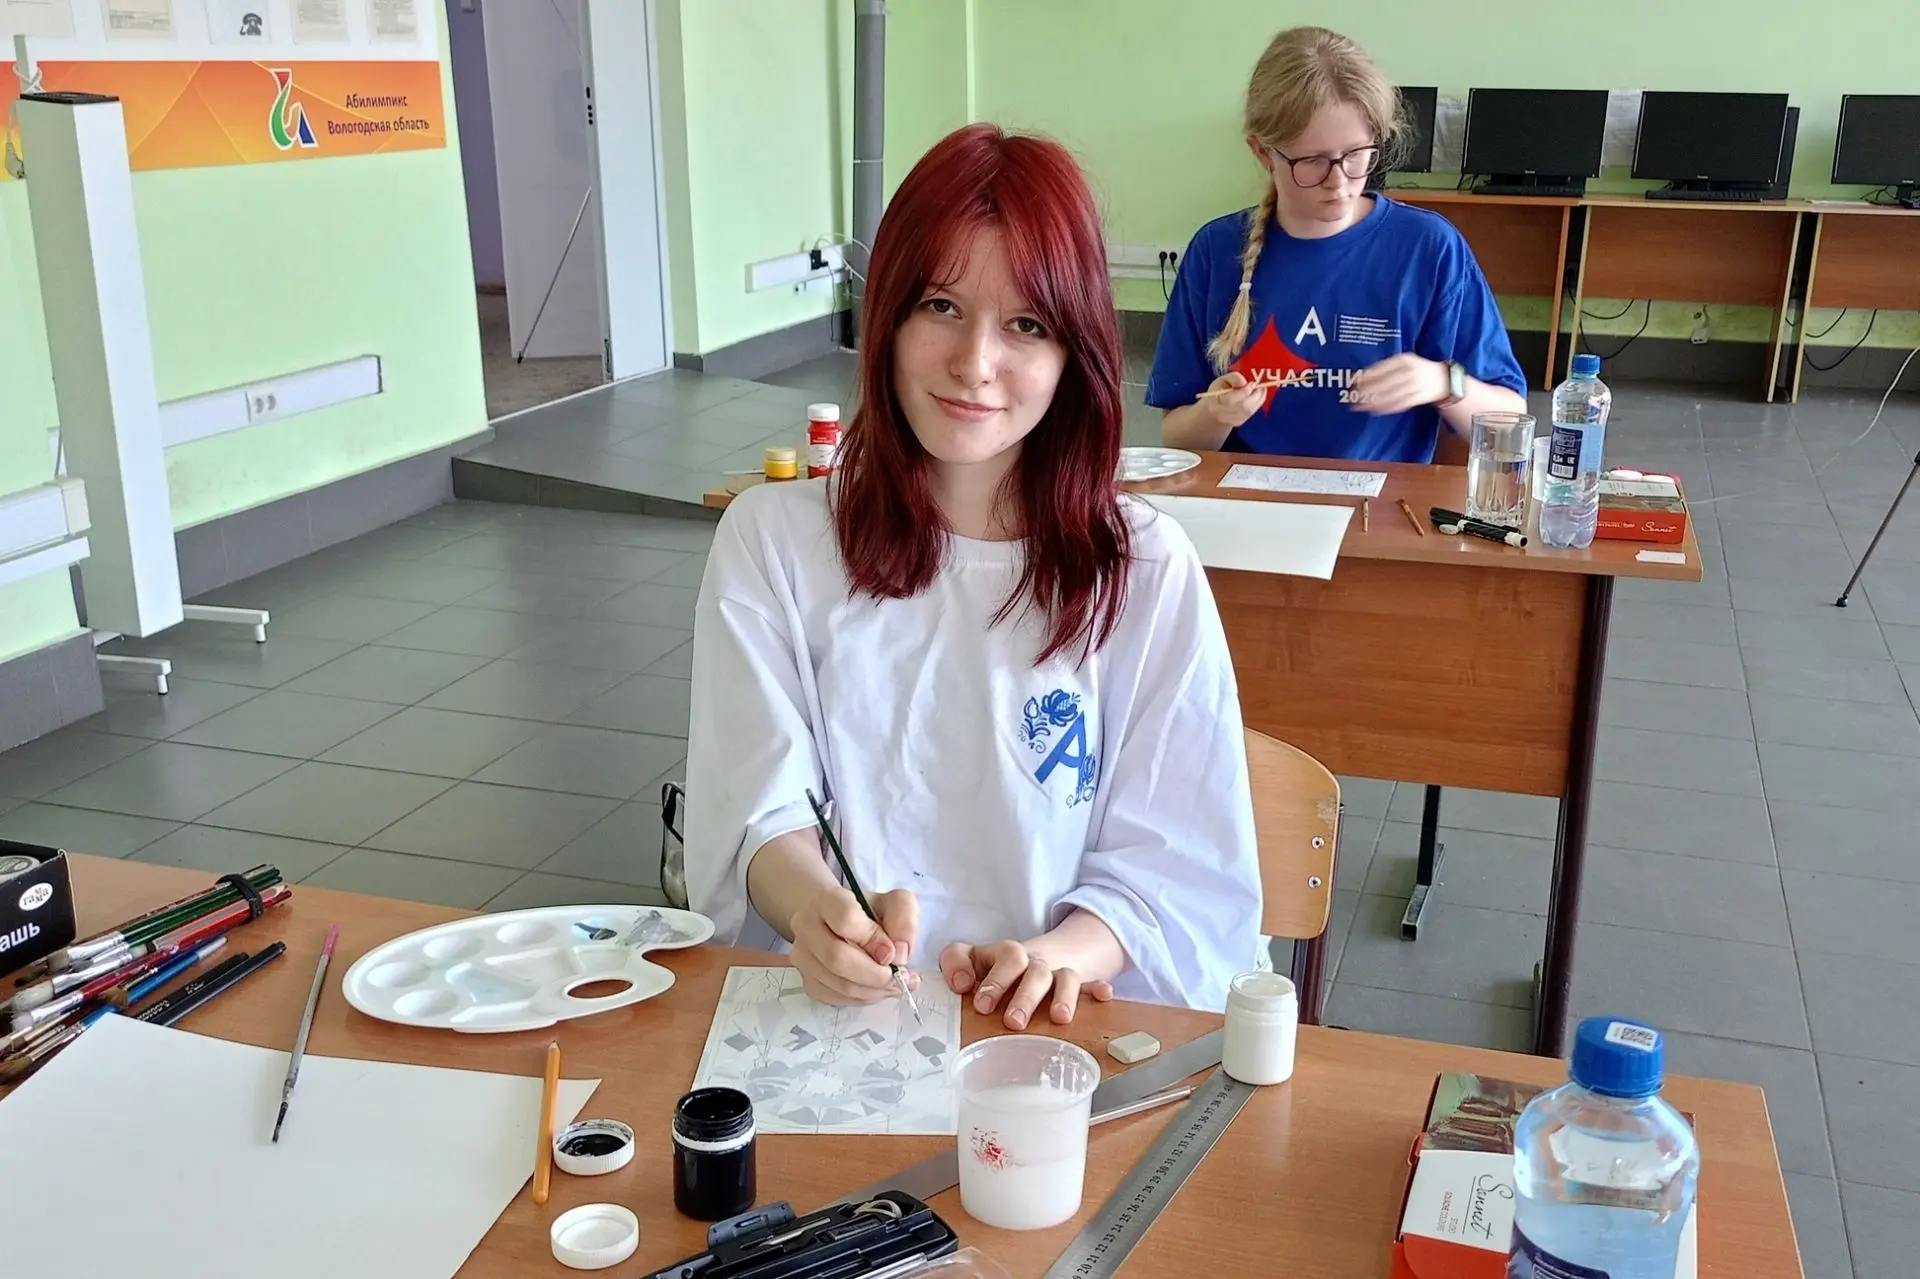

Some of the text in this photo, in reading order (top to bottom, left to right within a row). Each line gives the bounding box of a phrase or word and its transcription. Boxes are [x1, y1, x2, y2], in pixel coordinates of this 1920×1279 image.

[345, 93, 409, 109] Абилимпикс
[327, 116, 430, 136] Вологодская область
[1251, 368, 1364, 388] УЧАСТНИ
[1641, 521, 1677, 533] Sonnet
[1077, 1264, 1092, 1275] 20
[1086, 1255, 1100, 1263] 21
[1095, 1244, 1108, 1253] 22
[1103, 1233, 1116, 1243] 23
[1111, 1224, 1124, 1232] 24
[1119, 1213, 1132, 1222] 25
[1127, 1204, 1140, 1212] 26
[1134, 1194, 1147, 1203] 27
[1142, 1184, 1154, 1193] 28
[1149, 1176, 1161, 1184] 29
[1156, 1166, 1170, 1175] 30
[1164, 1158, 1176, 1166] 31
[1470, 1174, 1514, 1240] Sonnet
